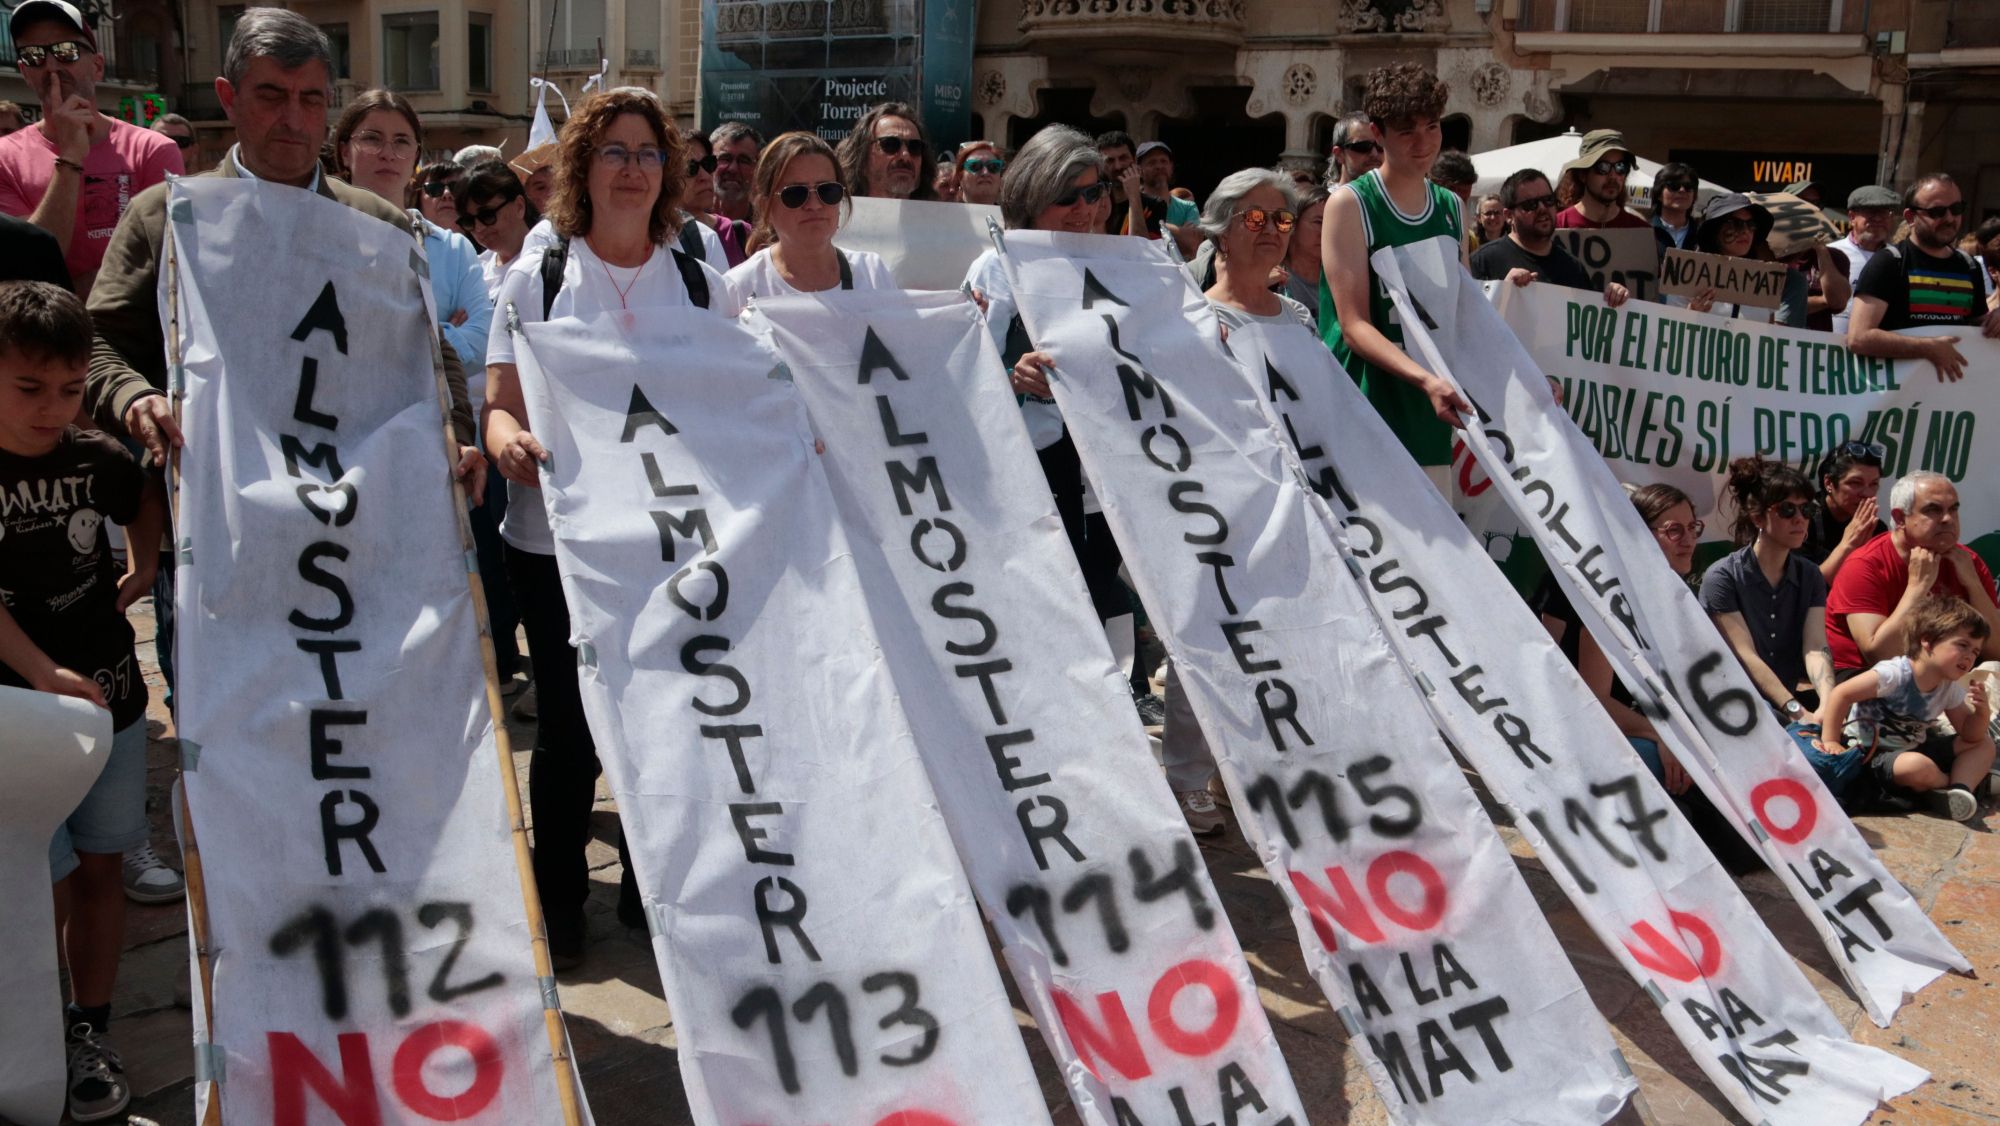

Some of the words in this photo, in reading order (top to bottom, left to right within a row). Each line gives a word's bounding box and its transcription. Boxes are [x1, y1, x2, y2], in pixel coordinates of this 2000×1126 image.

[825, 78, 887, 99] Projecte
[1753, 160, 1812, 183] VIVARI
[1566, 301, 1618, 364] POR
[1619, 311, 1648, 370] EL
[1653, 317, 1751, 386] FUTURO
[1757, 335, 1790, 391] DE
[1797, 340, 1901, 396] TERUEL
[0, 474, 95, 517] WHAT!
[1692, 396, 1732, 475] SÍ
[1921, 410, 1976, 483] NO
[1083, 266, 1314, 752] ALMOSTER
[1264, 351, 1553, 769] ALMOSTER
[279, 280, 387, 876] ALMOSTER
[857, 325, 1088, 872] ALMOSTER
[620, 383, 824, 965] ALMOSTER
[1245, 754, 1424, 851] 115
[1526, 775, 1668, 895] 117
[1006, 839, 1216, 968] 114
[1288, 849, 1447, 954] NO
[268, 902, 507, 1022] 112
[1348, 962, 1393, 1020] A
[1399, 943, 1479, 1006] LA
[266, 1019, 506, 1126] NO
[731, 970, 940, 1097] 113
[1050, 958, 1241, 1083] NO
[1367, 995, 1514, 1105] MAT
